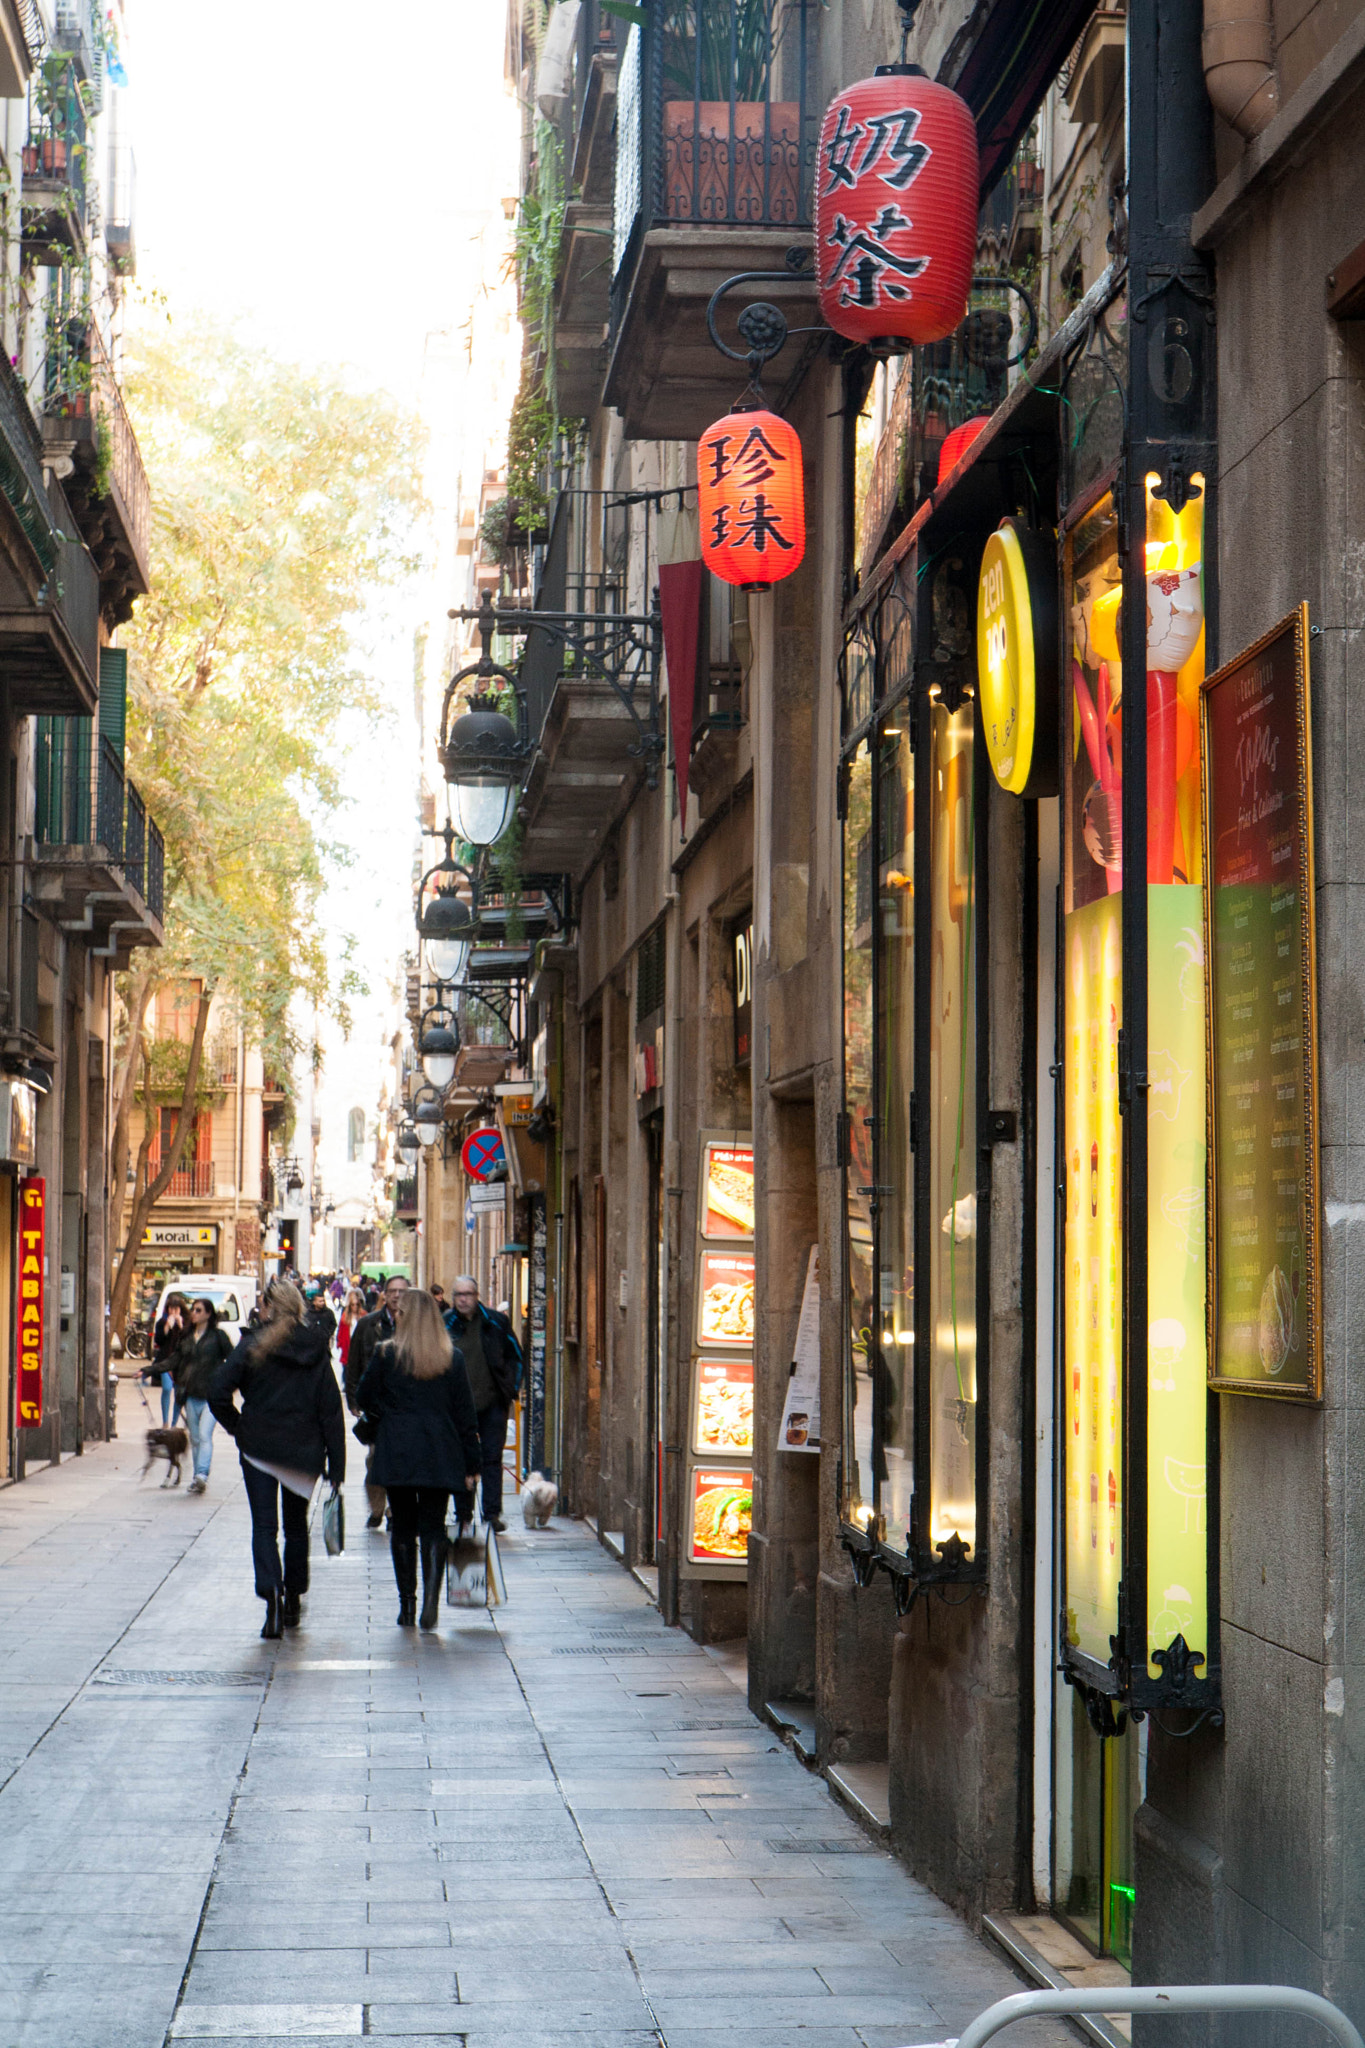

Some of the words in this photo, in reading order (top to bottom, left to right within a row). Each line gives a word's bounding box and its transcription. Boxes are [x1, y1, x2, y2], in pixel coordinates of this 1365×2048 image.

[820, 105, 933, 308] 奶茶
[706, 426, 796, 553] 珍珠
[982, 559, 1005, 619] zen
[986, 614, 1007, 673] zoo
[1235, 725, 1280, 801] Tapas
[22, 1231, 41, 1371] TABACS
